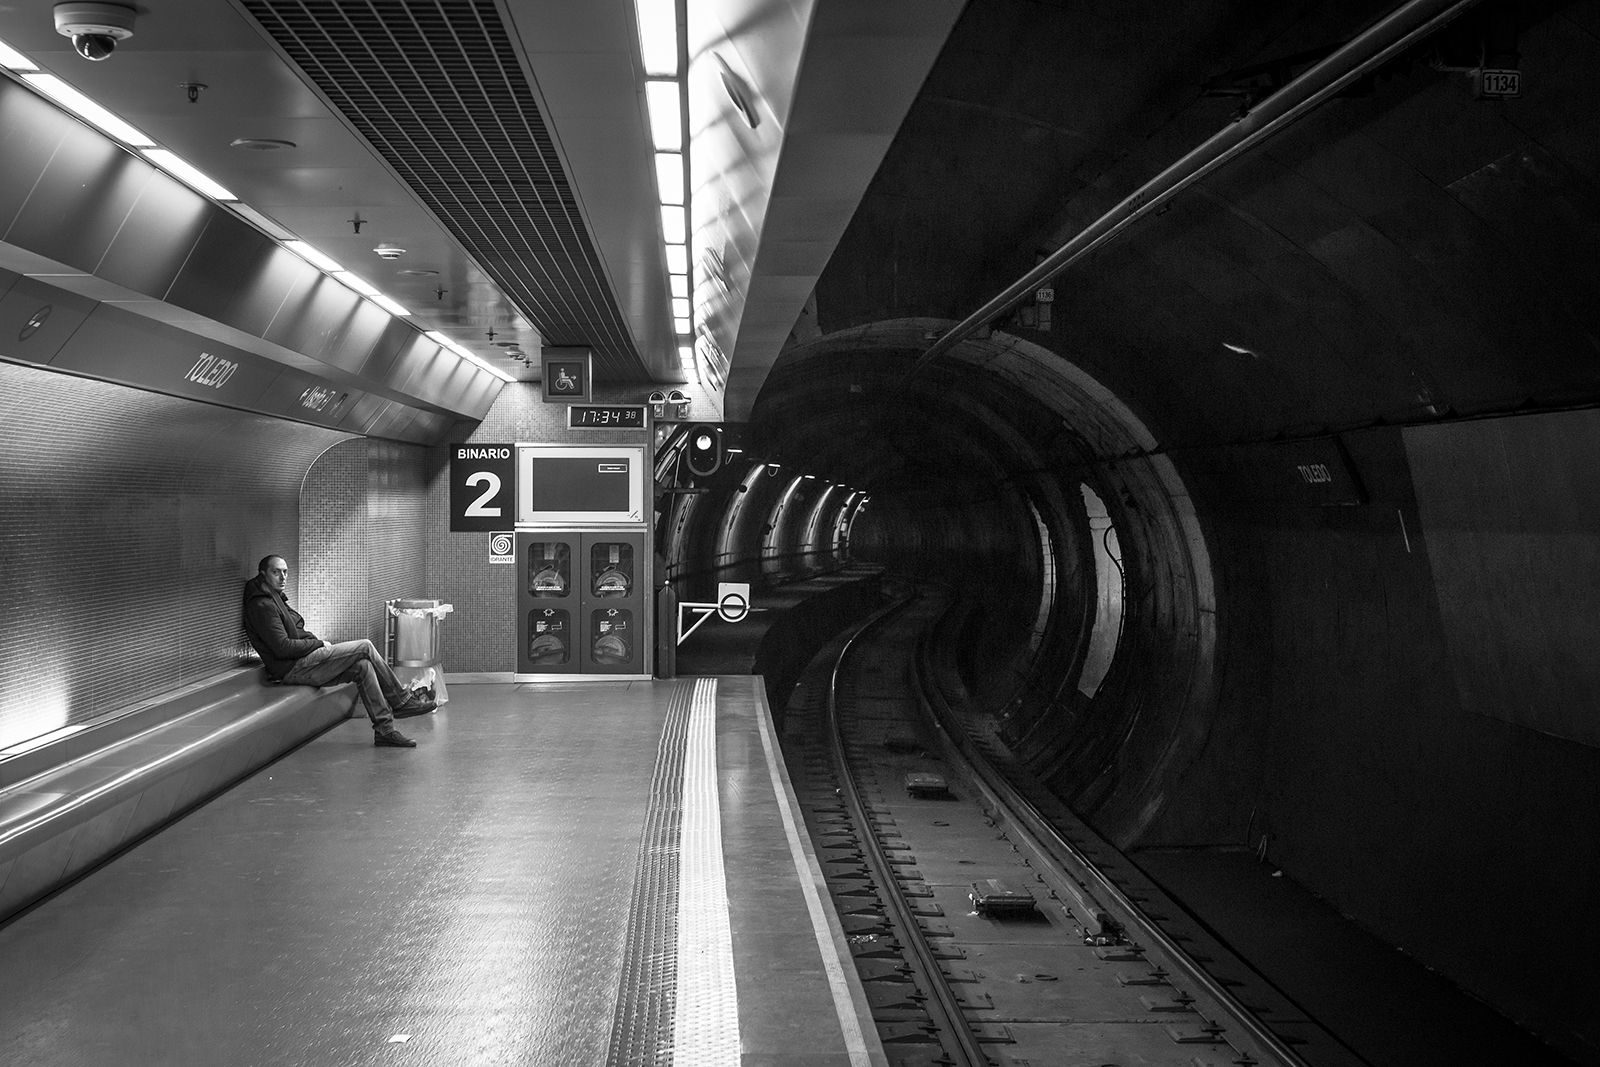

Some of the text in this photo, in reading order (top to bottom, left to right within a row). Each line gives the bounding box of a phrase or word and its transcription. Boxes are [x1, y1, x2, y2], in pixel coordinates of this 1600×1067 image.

[184, 352, 239, 389] TOLEDO
[582, 410, 636, 423] 17:34 38
[457, 448, 511, 460] BINARIO
[1297, 463, 1332, 483] TOLEDO
[464, 472, 502, 517] 2
